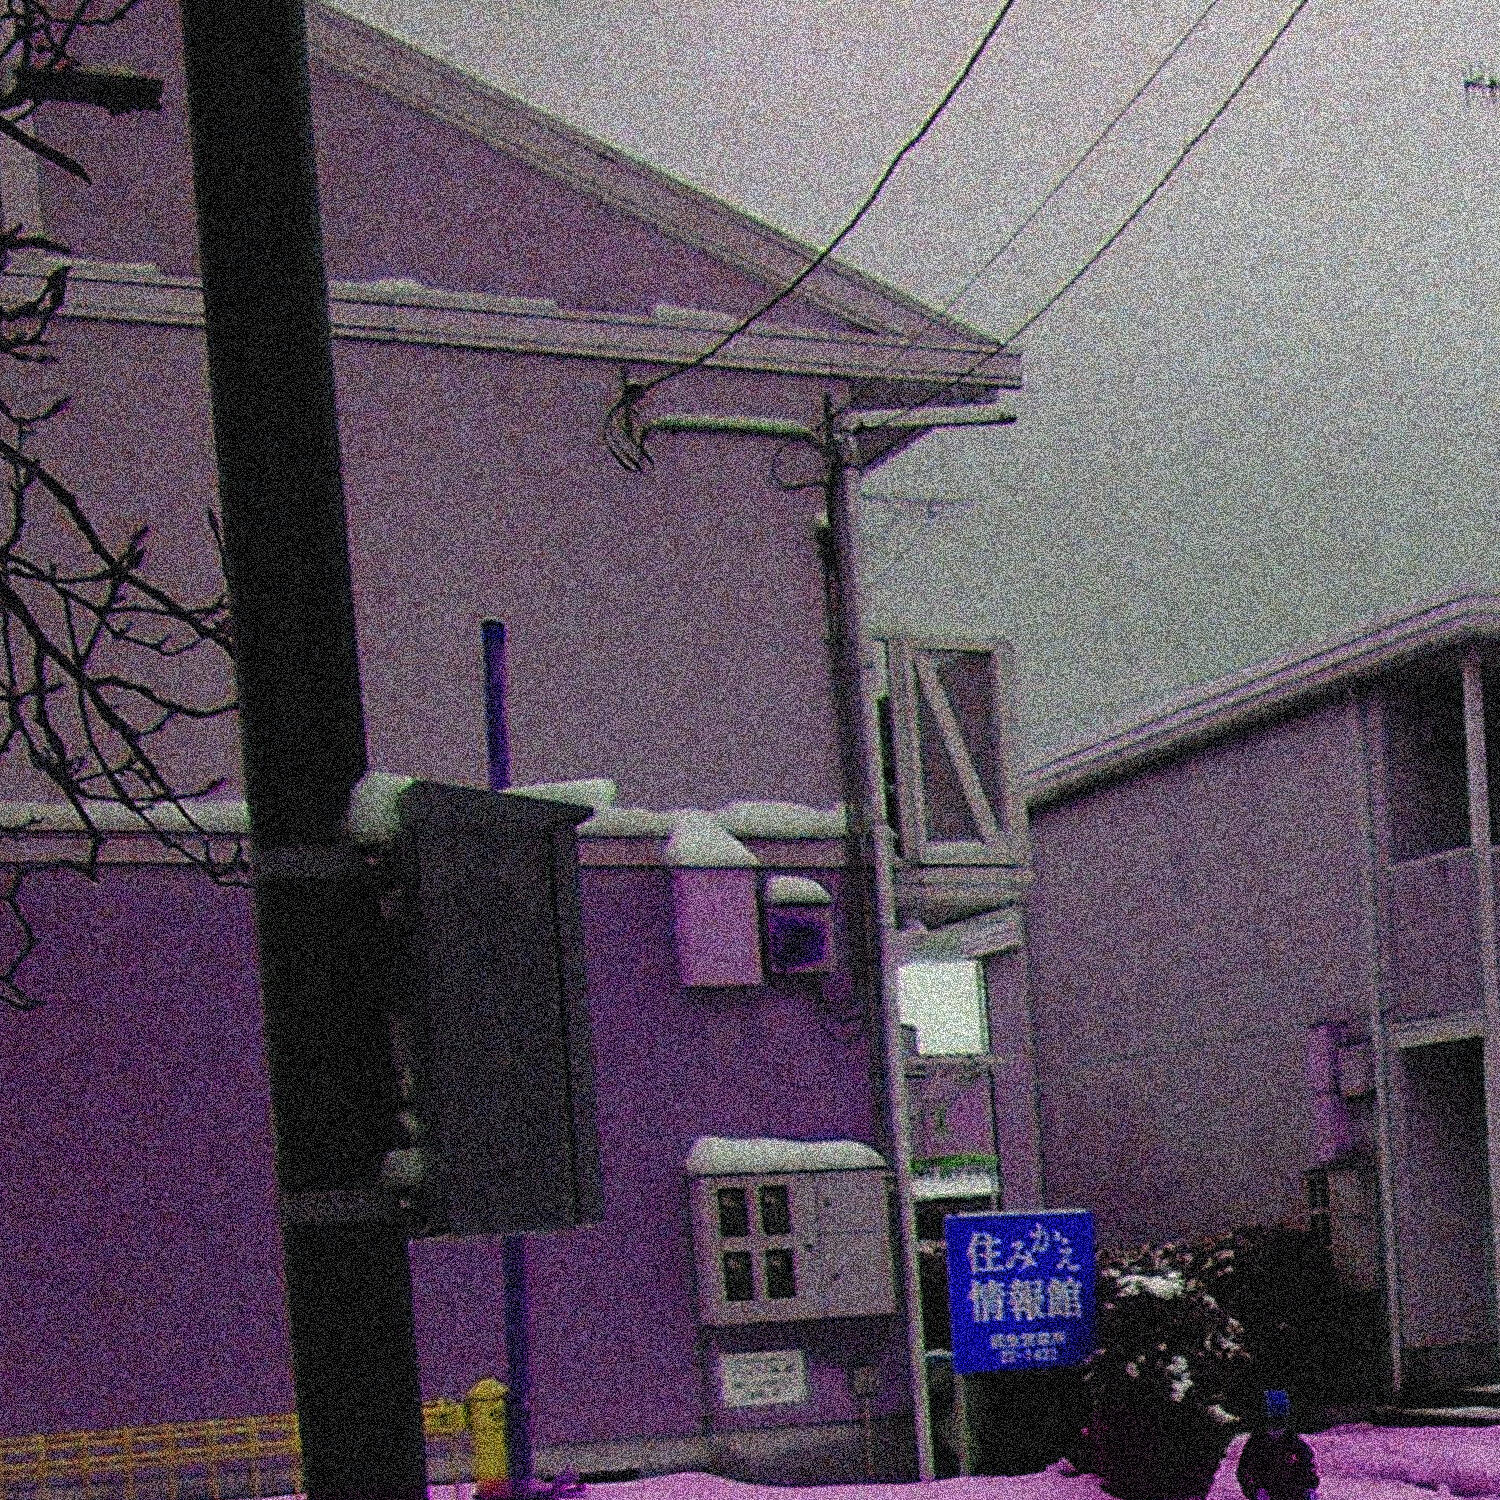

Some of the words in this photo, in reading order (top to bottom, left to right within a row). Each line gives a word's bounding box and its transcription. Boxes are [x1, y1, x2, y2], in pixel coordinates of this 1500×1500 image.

[966, 1221, 1081, 1275] 住みかえ
[966, 1276, 1083, 1323] 情報館
